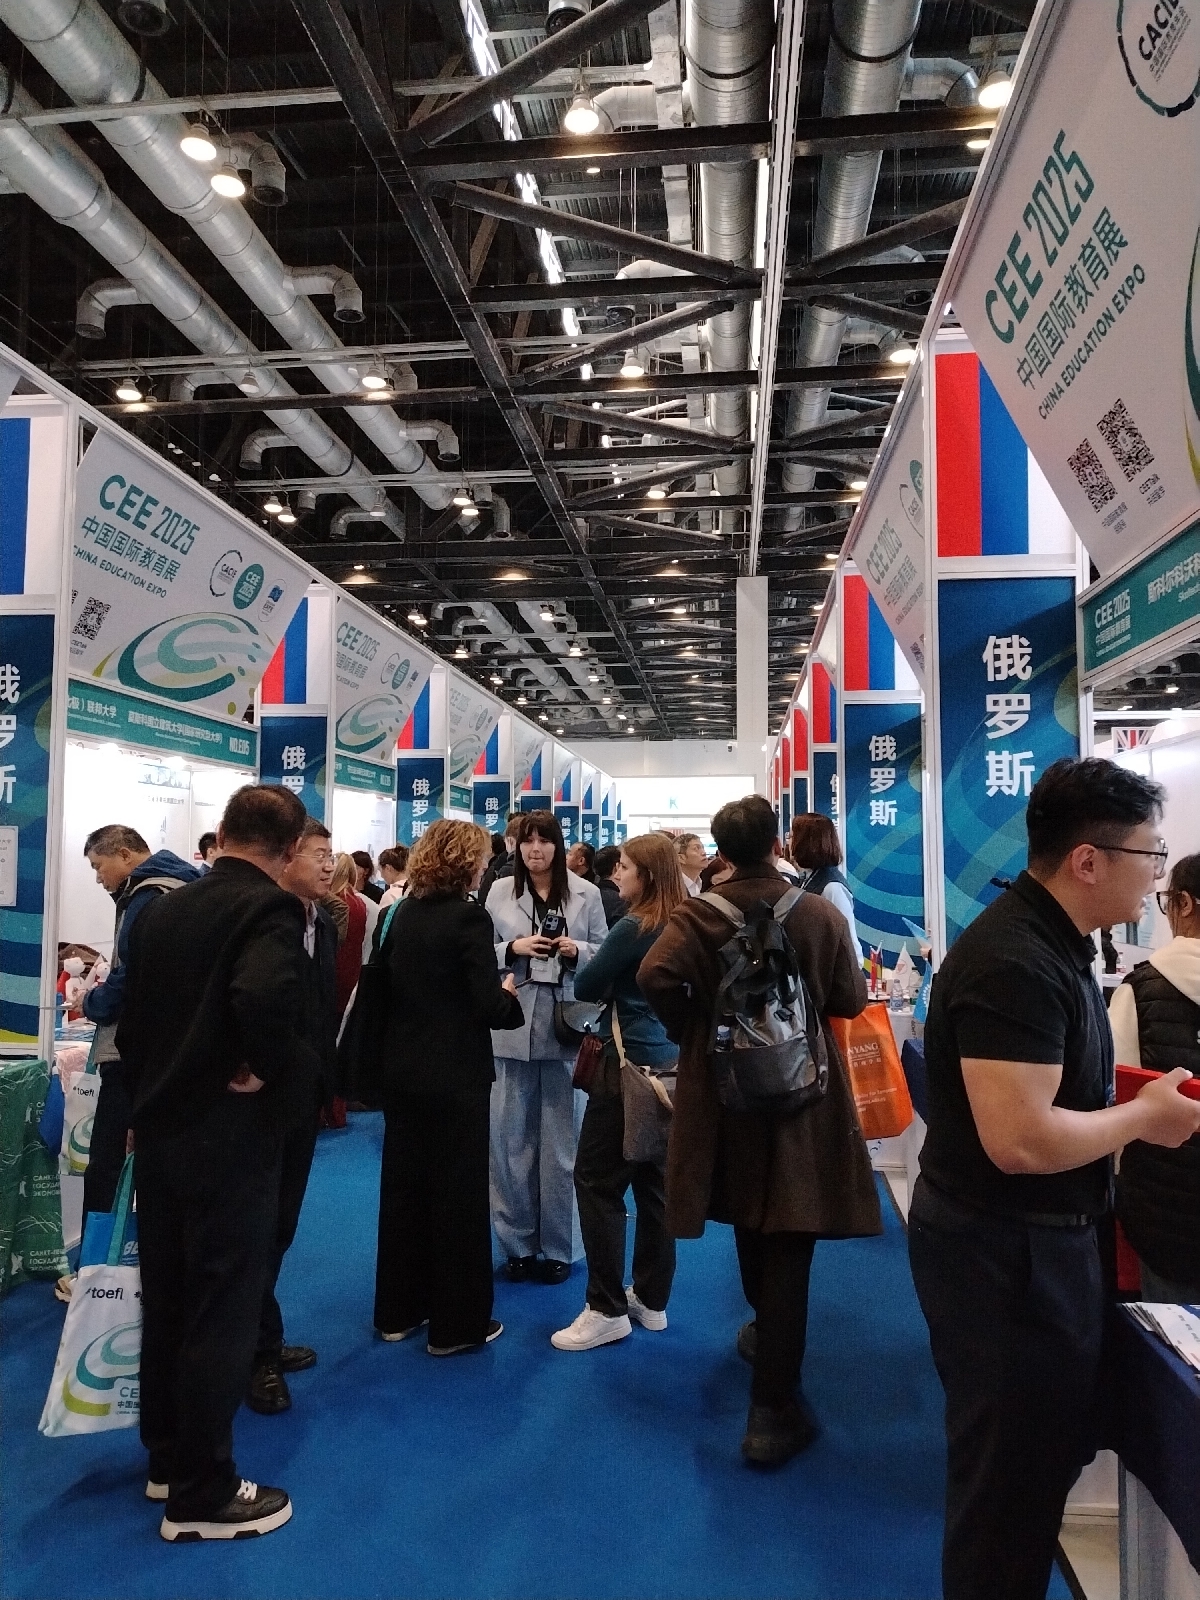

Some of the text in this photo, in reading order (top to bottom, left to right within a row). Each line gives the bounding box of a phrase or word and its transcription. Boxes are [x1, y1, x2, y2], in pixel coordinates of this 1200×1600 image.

[985, 128, 1095, 345] CEE 2025
[1017, 205, 1129, 391] 中国国际教育展
[1038, 263, 1146, 420] CHINA EDUCATION EXPO
[81, 515, 181, 583] 中国国际教育展
[99, 474, 201, 556] CEE 2025
[99, 558, 147, 589] EDUCATION
[145, 582, 168, 599] EXPO
[245, 571, 261, 587] CEE
[866, 518, 903, 586] CEE 2025
[336, 621, 381, 662] CEE 2025
[1095, 588, 1131, 629] CEE 2025
[983, 635, 1036, 798] 俄罗斯
[412, 778, 430, 839] 俄罗斯
[868, 734, 898, 827] 俄罗斯
[485, 797, 499, 836] 俄罗
